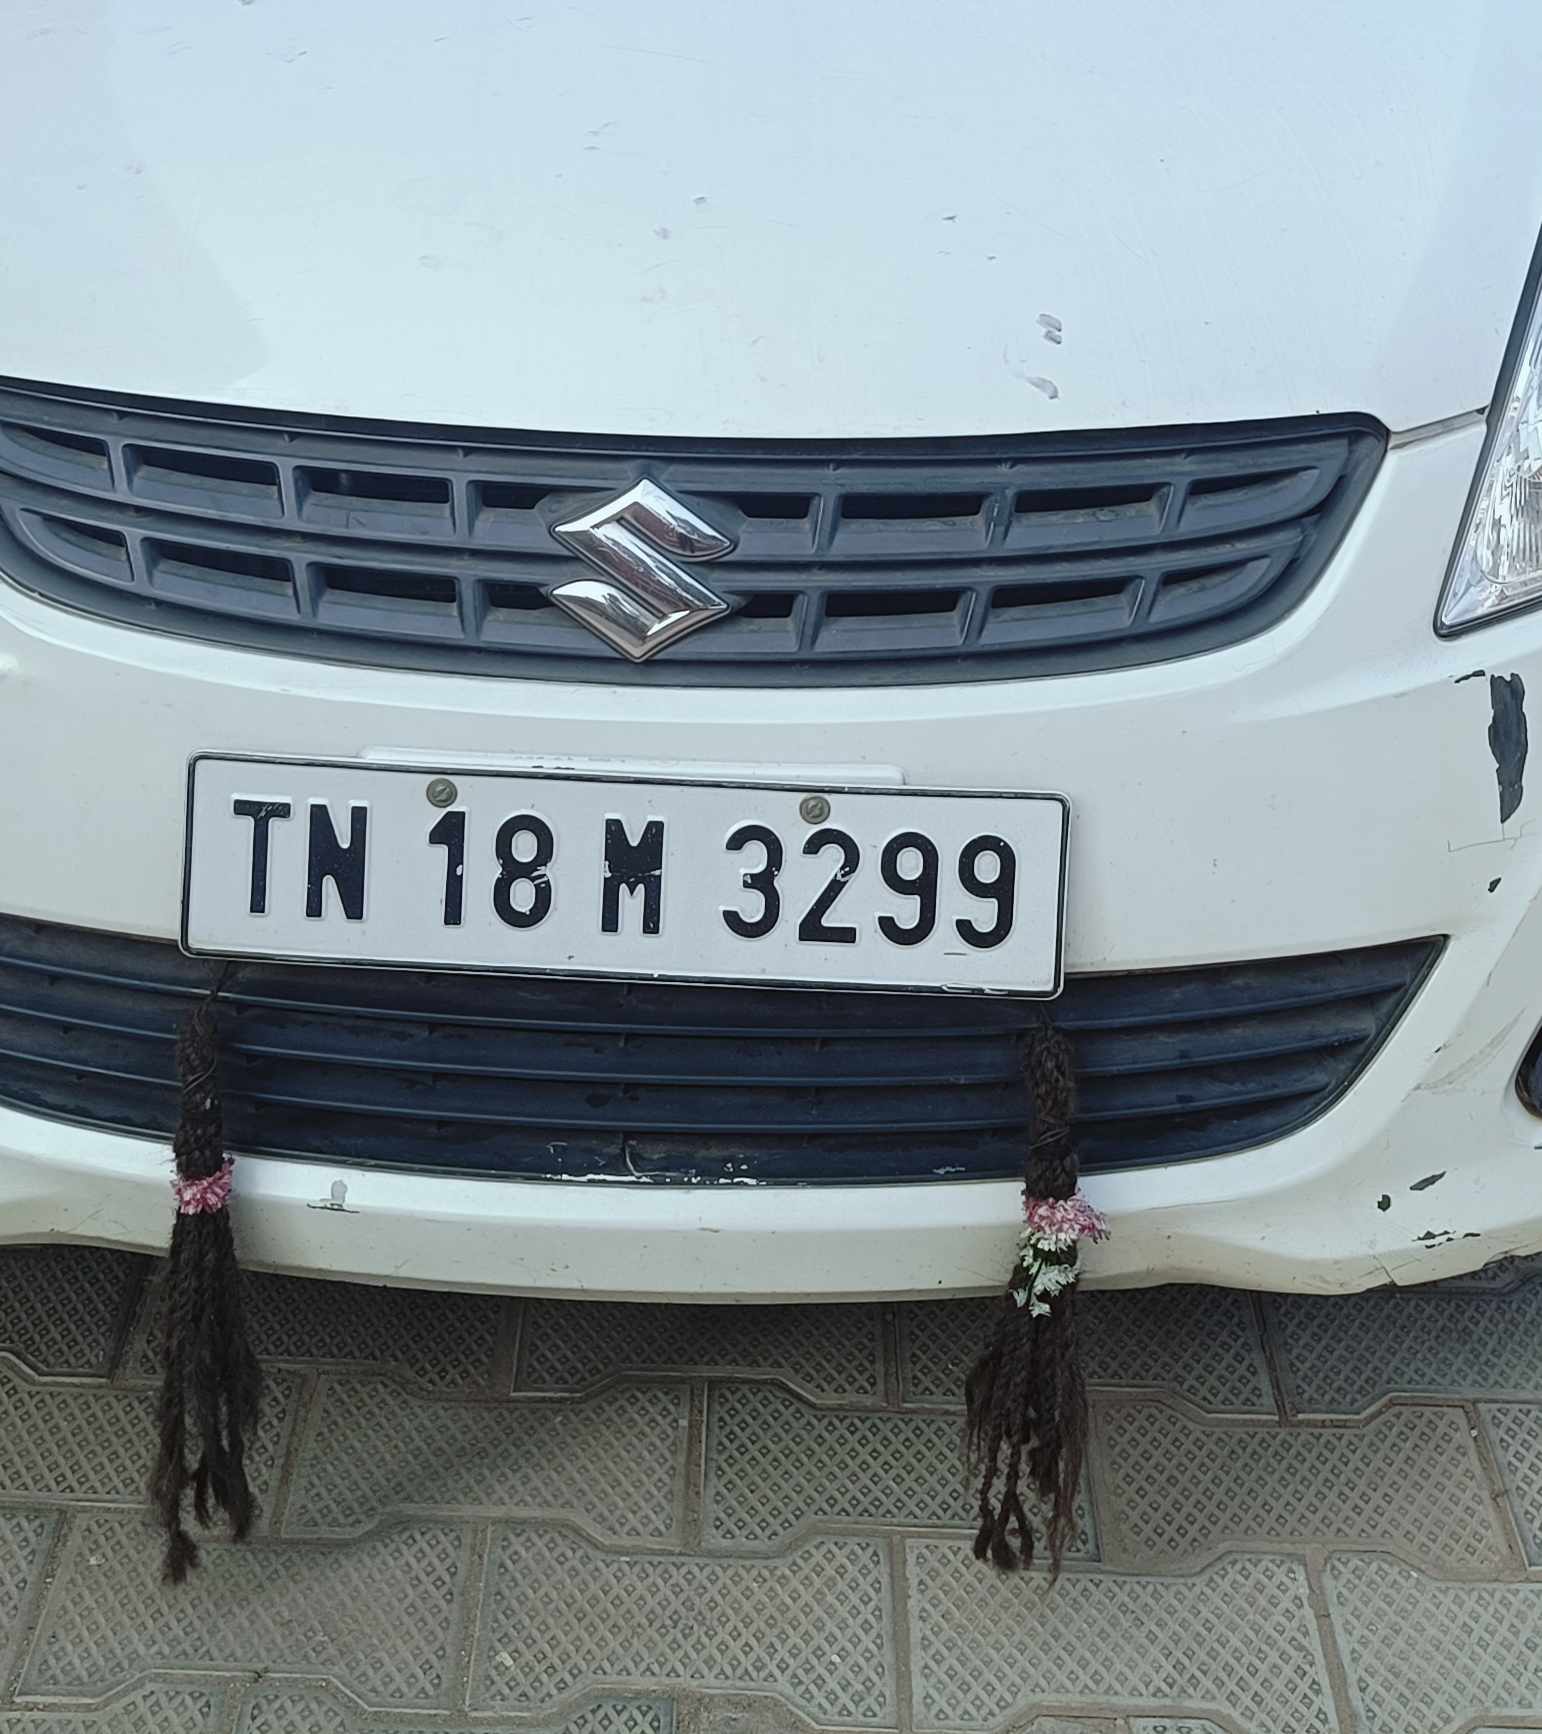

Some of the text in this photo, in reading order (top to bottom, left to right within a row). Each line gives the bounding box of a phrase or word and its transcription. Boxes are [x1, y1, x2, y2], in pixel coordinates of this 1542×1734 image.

[232, 798, 1019, 951] TN 18 M 3299
